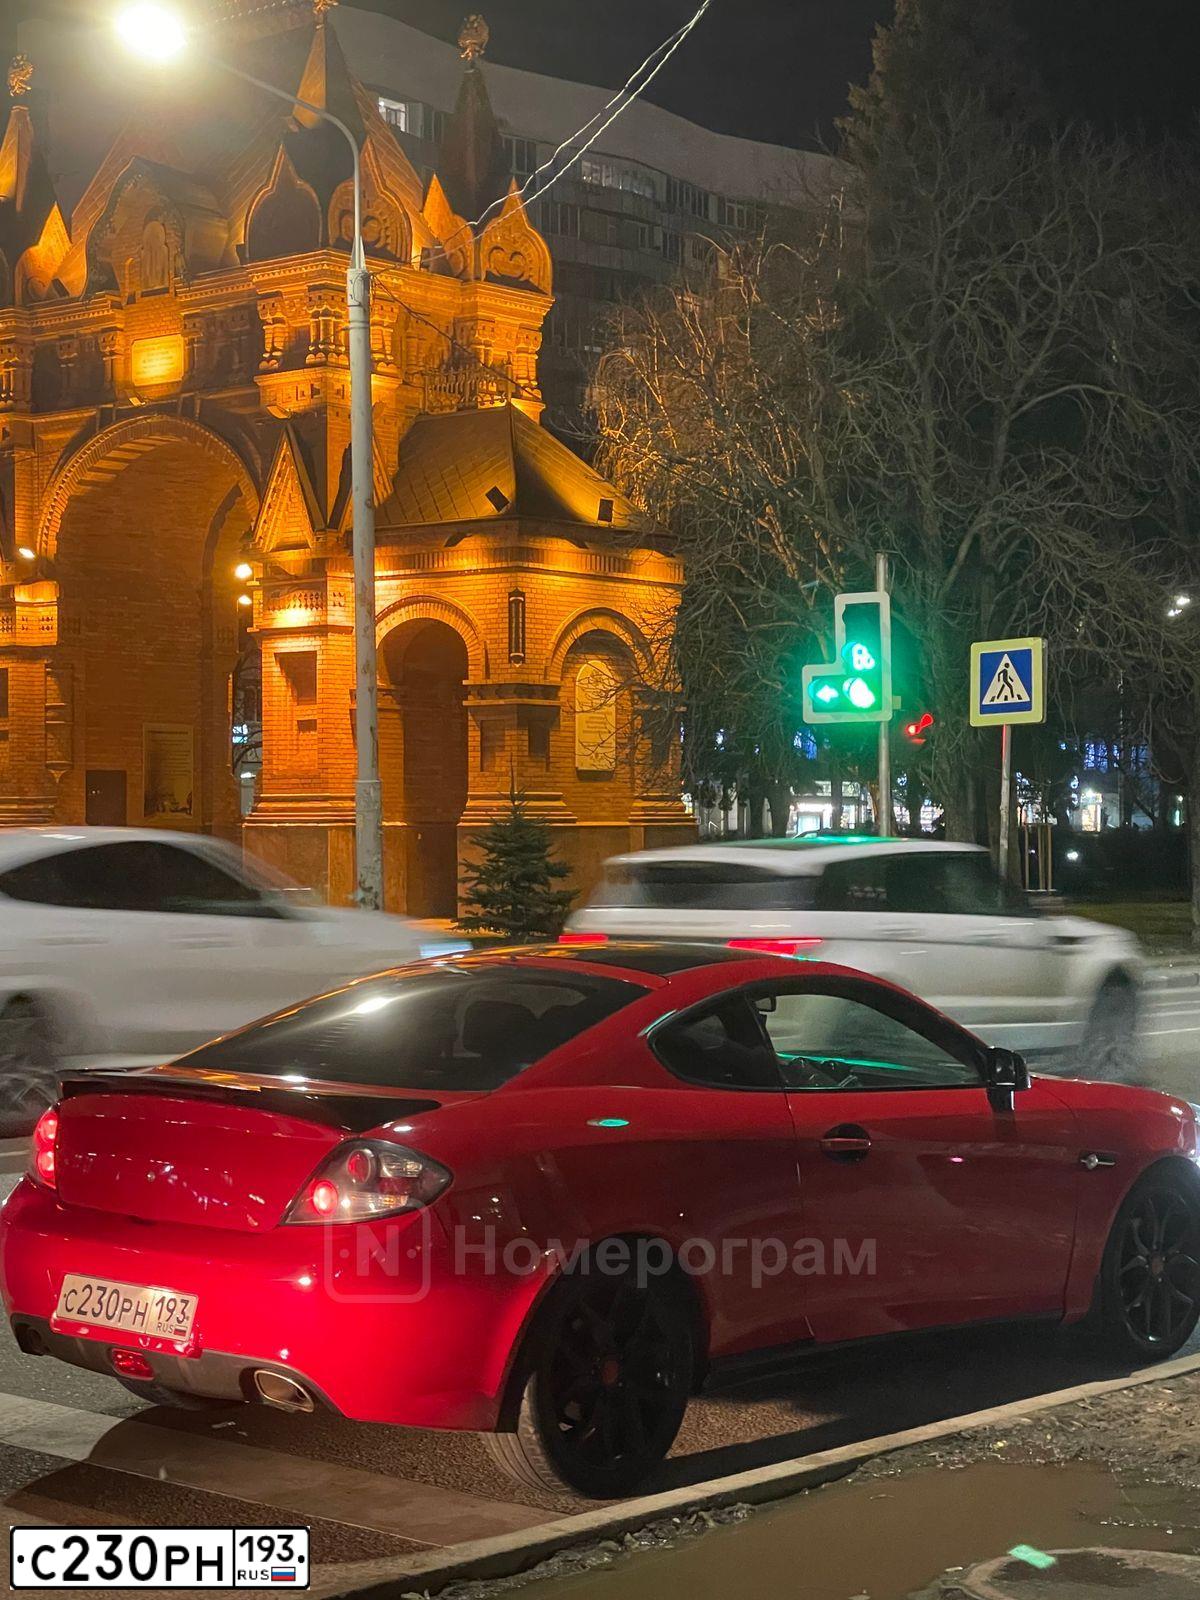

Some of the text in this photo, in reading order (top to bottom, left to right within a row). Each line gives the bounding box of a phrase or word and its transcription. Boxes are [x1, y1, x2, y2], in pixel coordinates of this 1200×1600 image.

[64, 1284, 190, 1327] С230РН 193
[157, 1322, 174, 1334] RUS
